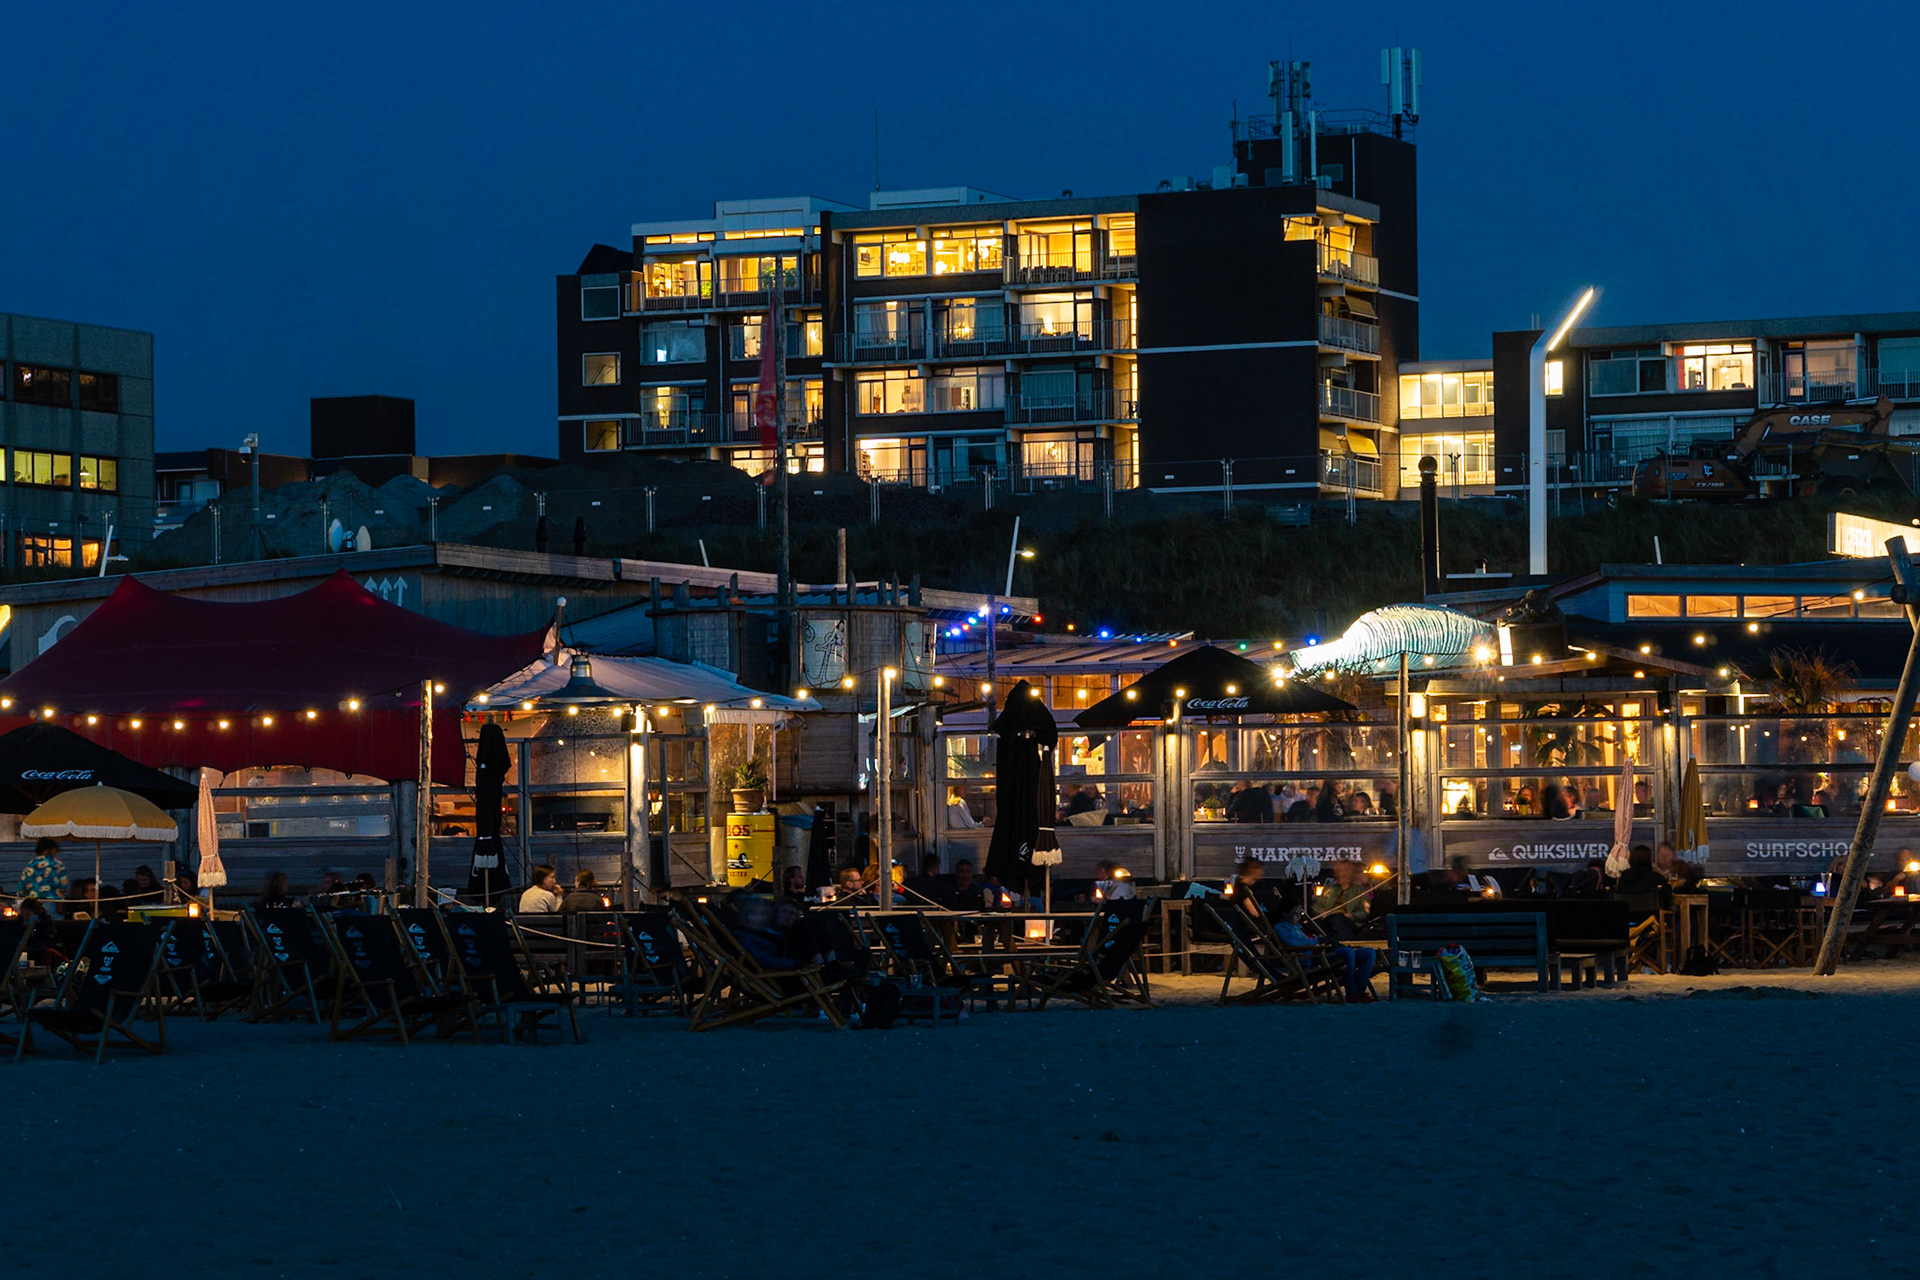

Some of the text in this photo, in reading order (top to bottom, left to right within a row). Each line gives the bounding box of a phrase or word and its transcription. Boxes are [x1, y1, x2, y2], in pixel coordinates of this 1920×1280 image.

[1789, 414, 1831, 426] CASE
[1512, 843, 1609, 860] QUIKSILVER
[1746, 841, 1874, 858] SURFSCHO
